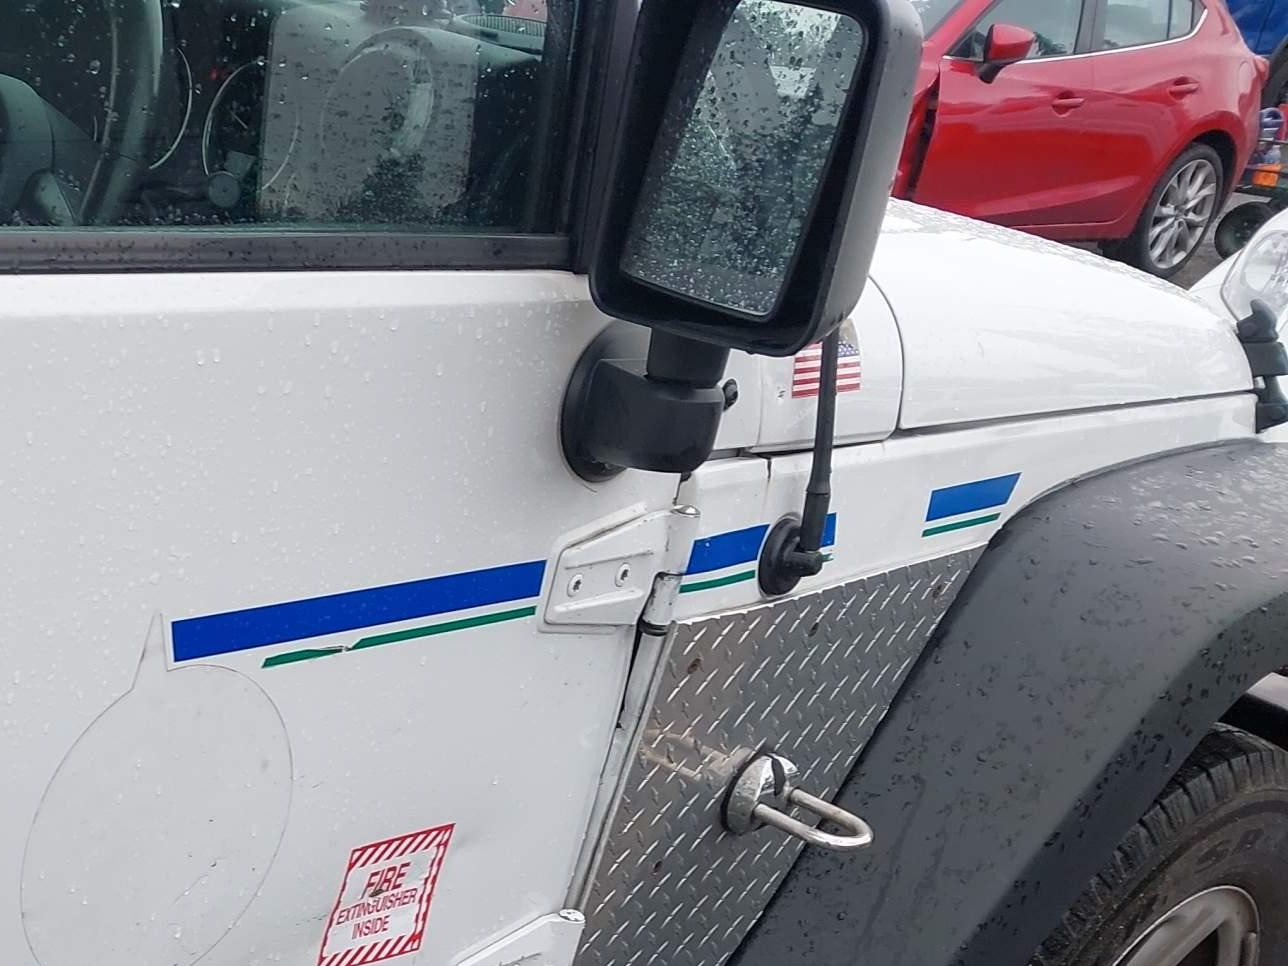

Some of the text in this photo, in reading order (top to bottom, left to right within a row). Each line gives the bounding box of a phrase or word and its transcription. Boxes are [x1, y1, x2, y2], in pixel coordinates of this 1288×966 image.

[362, 862, 411, 898] FIRE
[336, 887, 418, 925] EXTINGUISHER
[352, 914, 391, 940] INSIDE
